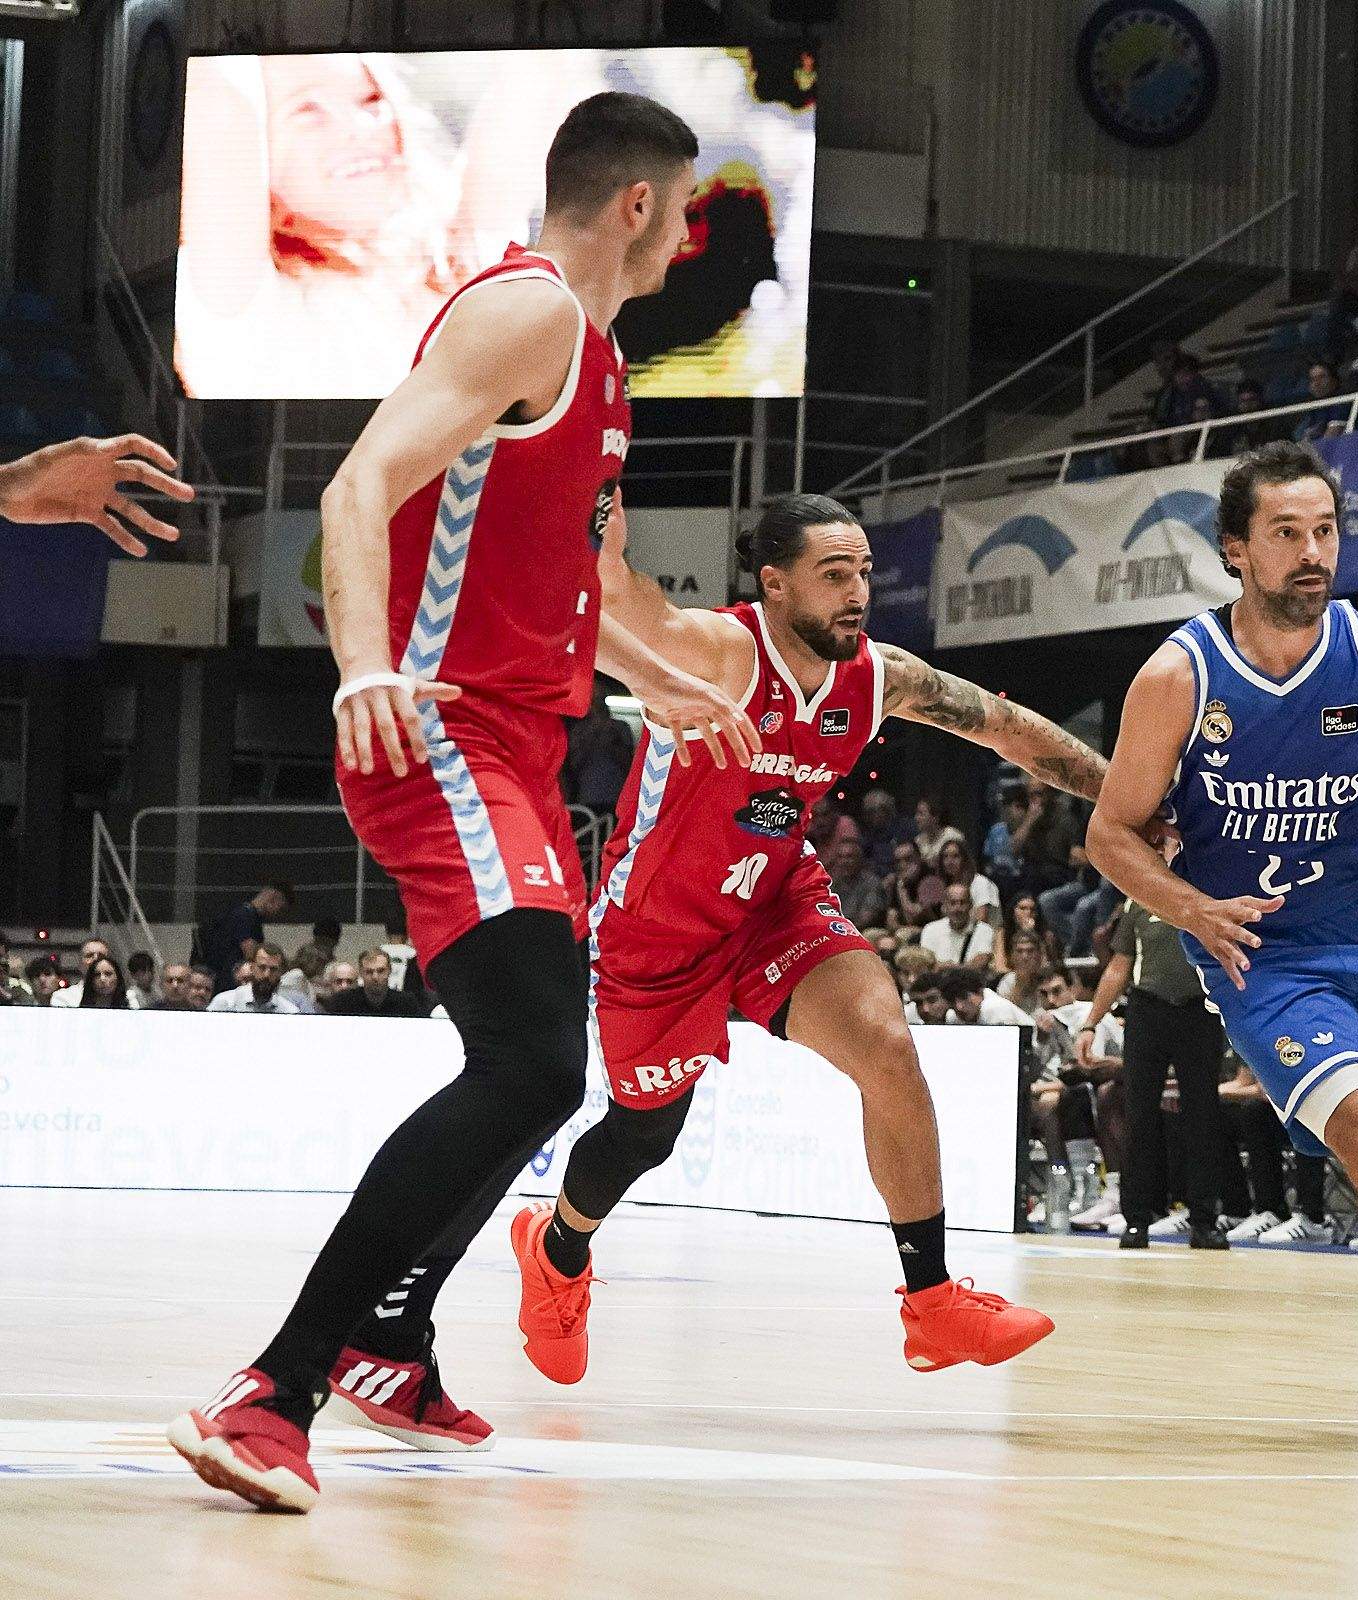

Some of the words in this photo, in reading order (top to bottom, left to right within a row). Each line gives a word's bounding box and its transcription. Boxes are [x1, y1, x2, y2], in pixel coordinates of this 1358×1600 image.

[1222, 810, 1258, 841] FLY
[1262, 810, 1340, 842] BETTER
[720, 852, 769, 900] 10
[793, 935, 831, 961] GALICIA
[634, 1054, 712, 1093] Río
